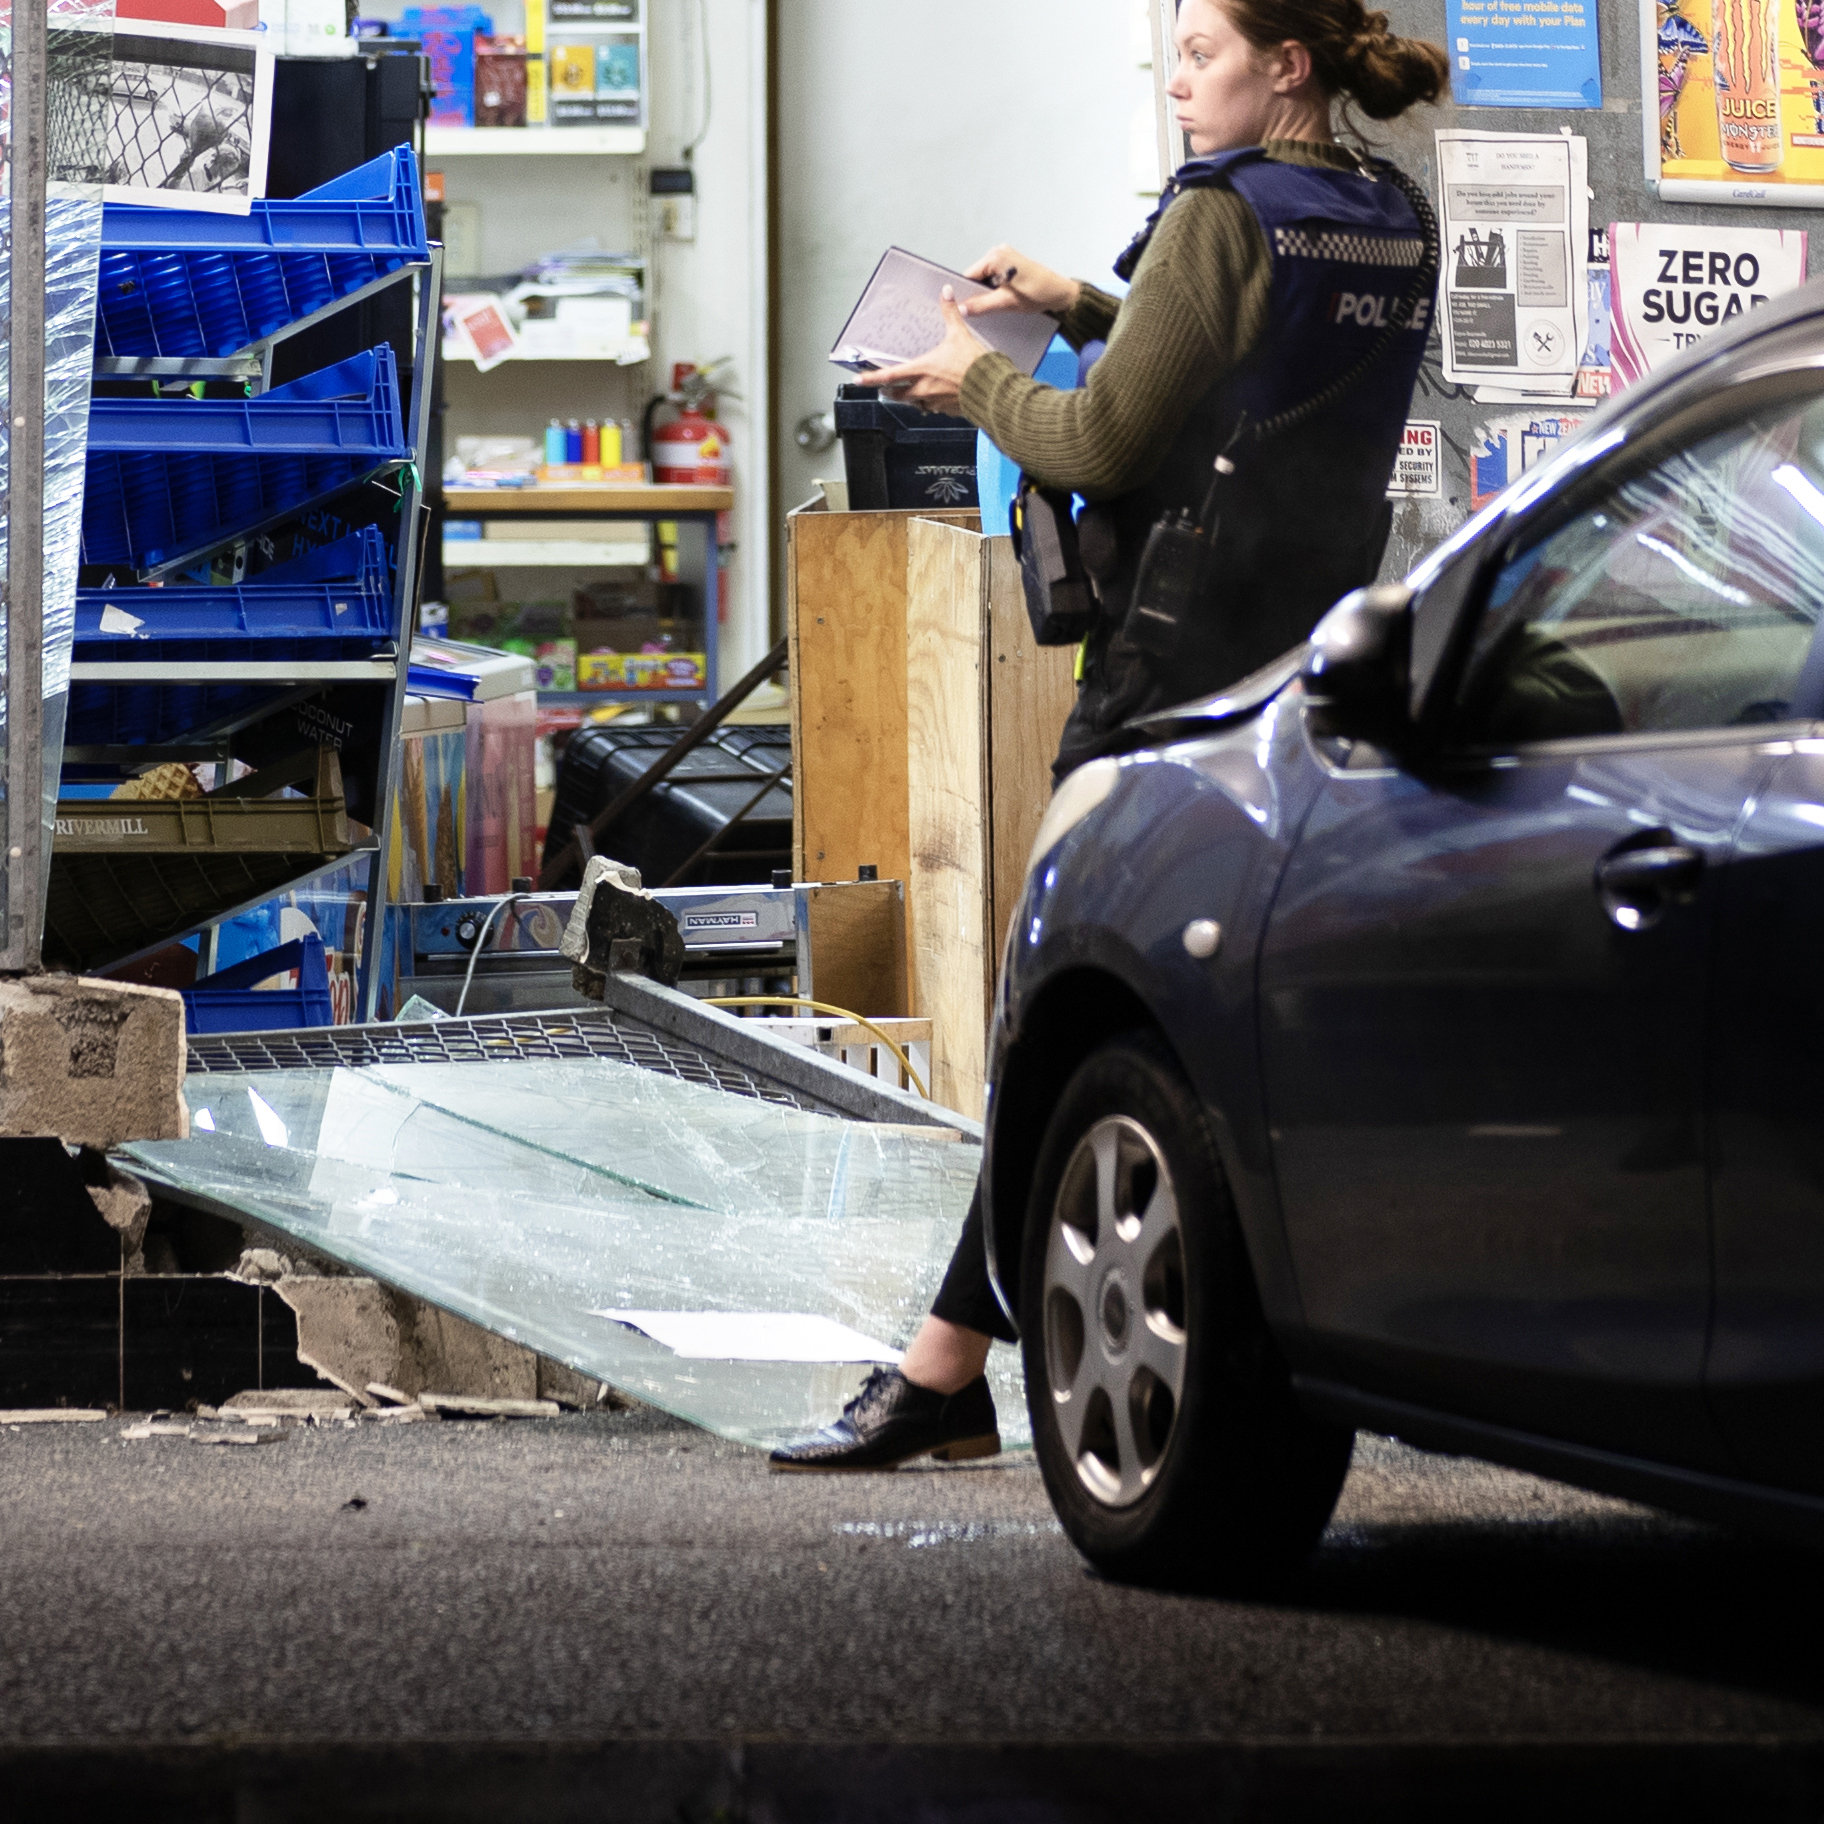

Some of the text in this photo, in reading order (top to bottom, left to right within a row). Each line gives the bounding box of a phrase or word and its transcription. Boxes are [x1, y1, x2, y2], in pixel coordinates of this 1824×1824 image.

[1487, 1, 1499, 13] of
[1499, 1, 1522, 13] free
[1523, 2, 1559, 14] mobile
[1491, 15, 1511, 28] day
[1512, 15, 1536, 26] with
[1539, 16, 1562, 28] your
[1564, 16, 1586, 28] Plan
[1722, 98, 1776, 120] JUICE
[1656, 249, 1760, 288] ZERO
[1335, 292, 1431, 330] POLIE
[1537, 420, 1557, 435] NEW
[1417, 447, 1433, 456] BY
[1399, 461, 1433, 473] SECURITY
[1399, 473, 1433, 484] SYSTEMS
[54, 817, 149, 836] RIVERMILL
[689, 916, 739, 925] HAYMAN
